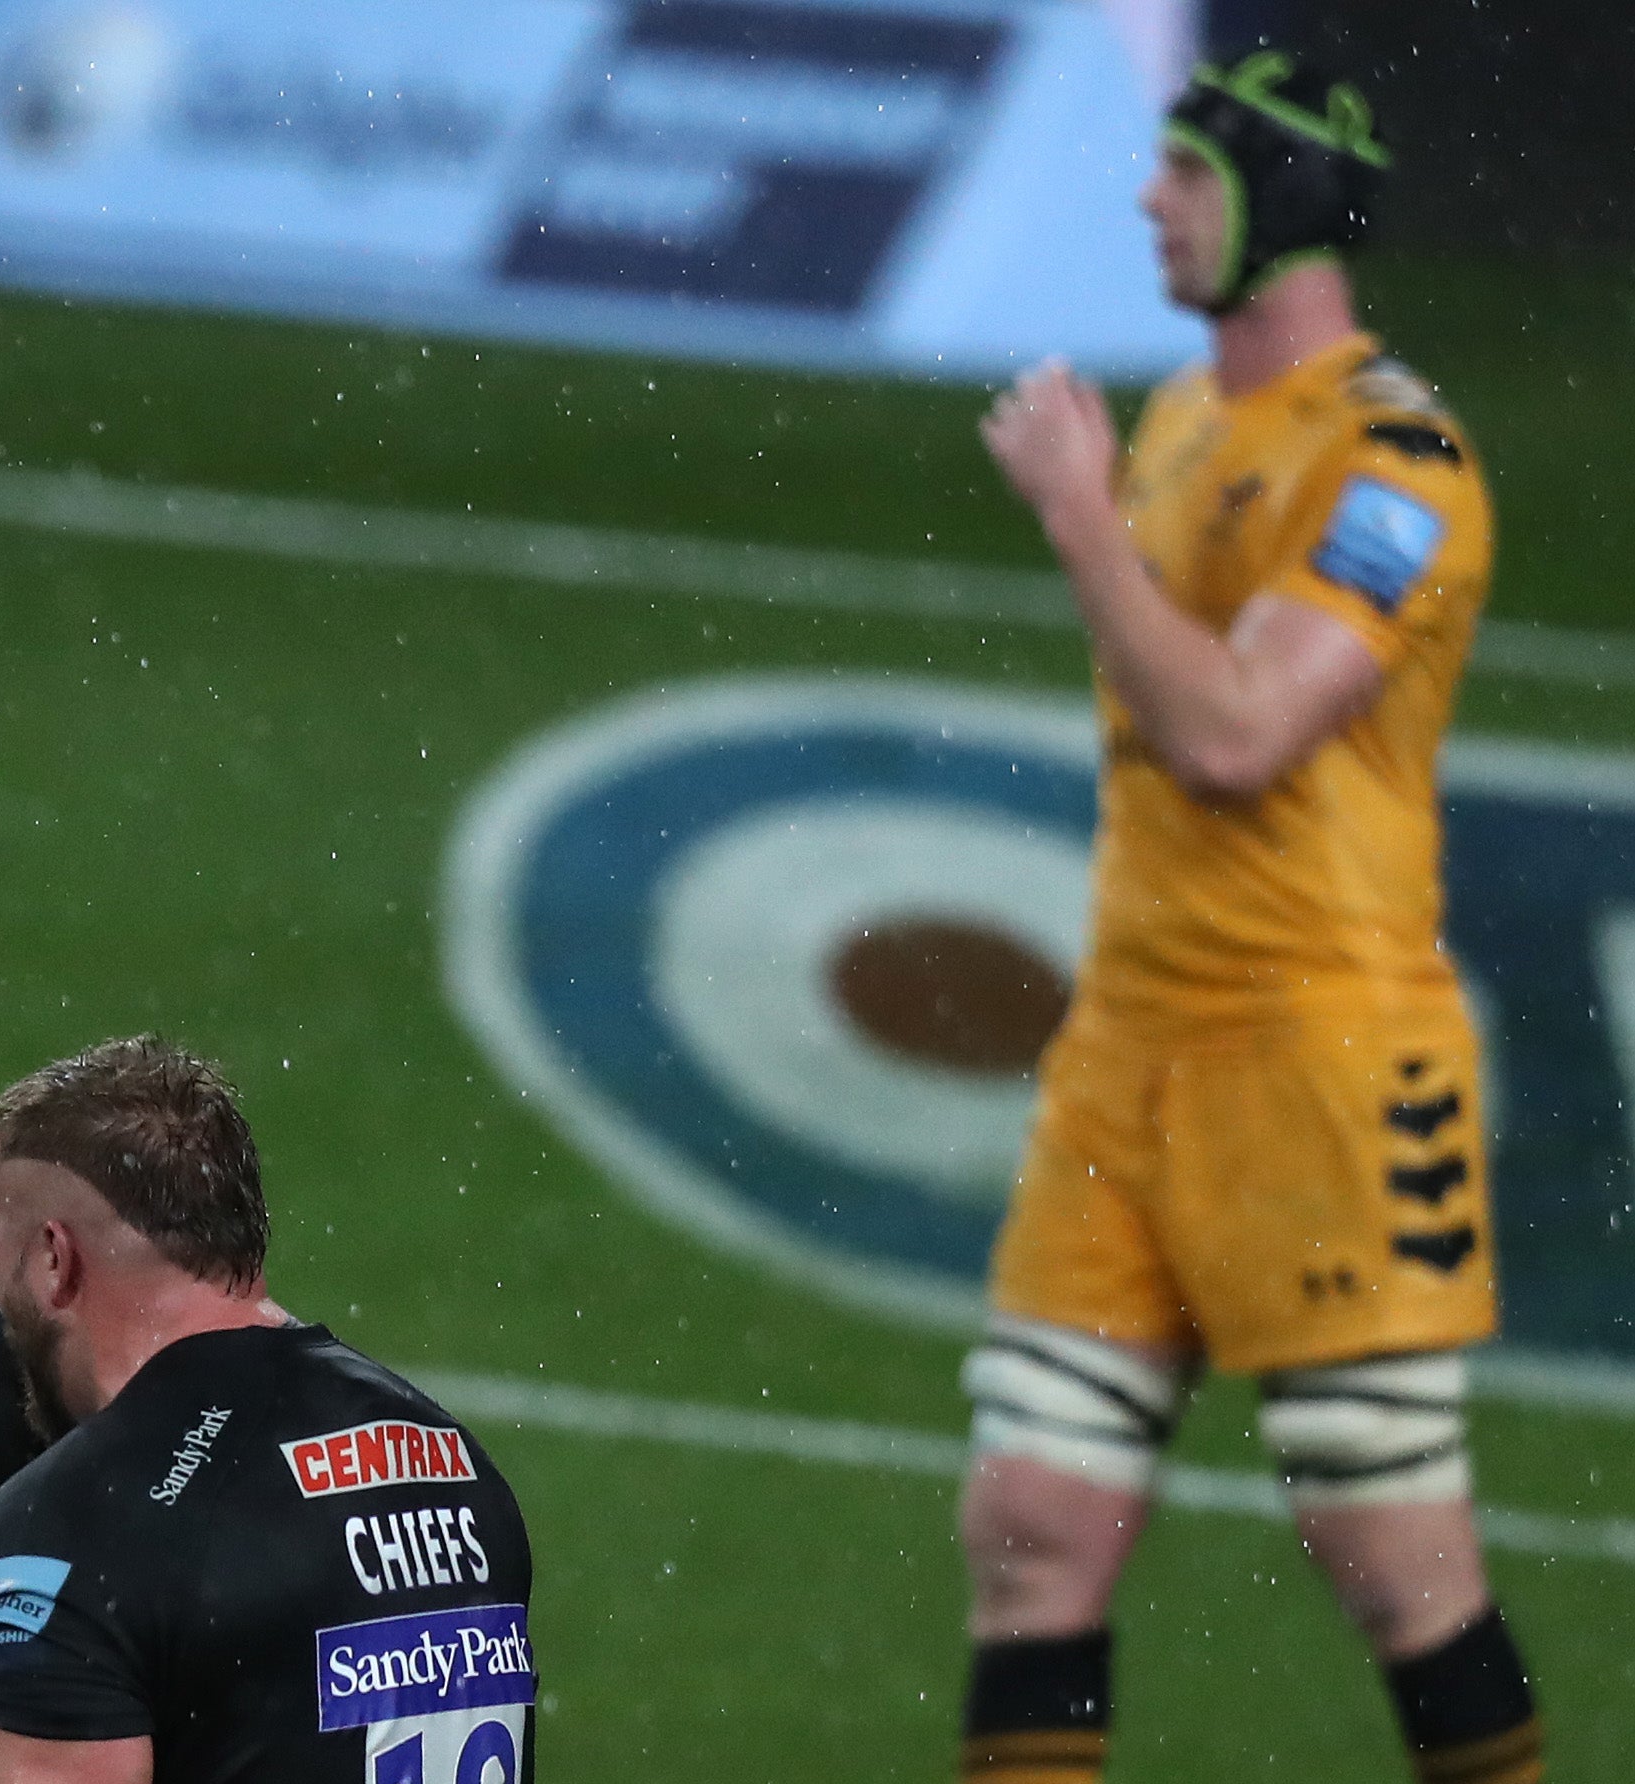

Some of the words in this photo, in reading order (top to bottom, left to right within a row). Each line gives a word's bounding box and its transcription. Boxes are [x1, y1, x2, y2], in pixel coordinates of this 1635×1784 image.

[149, 1447, 212, 1506] Sandy
[183, 1404, 233, 1453] Park
[293, 1425, 470, 1493] CENTRAX
[344, 1506, 490, 1596] CHIEFS
[329, 1631, 458, 1698] Sandy
[456, 1626, 531, 1681] Park
